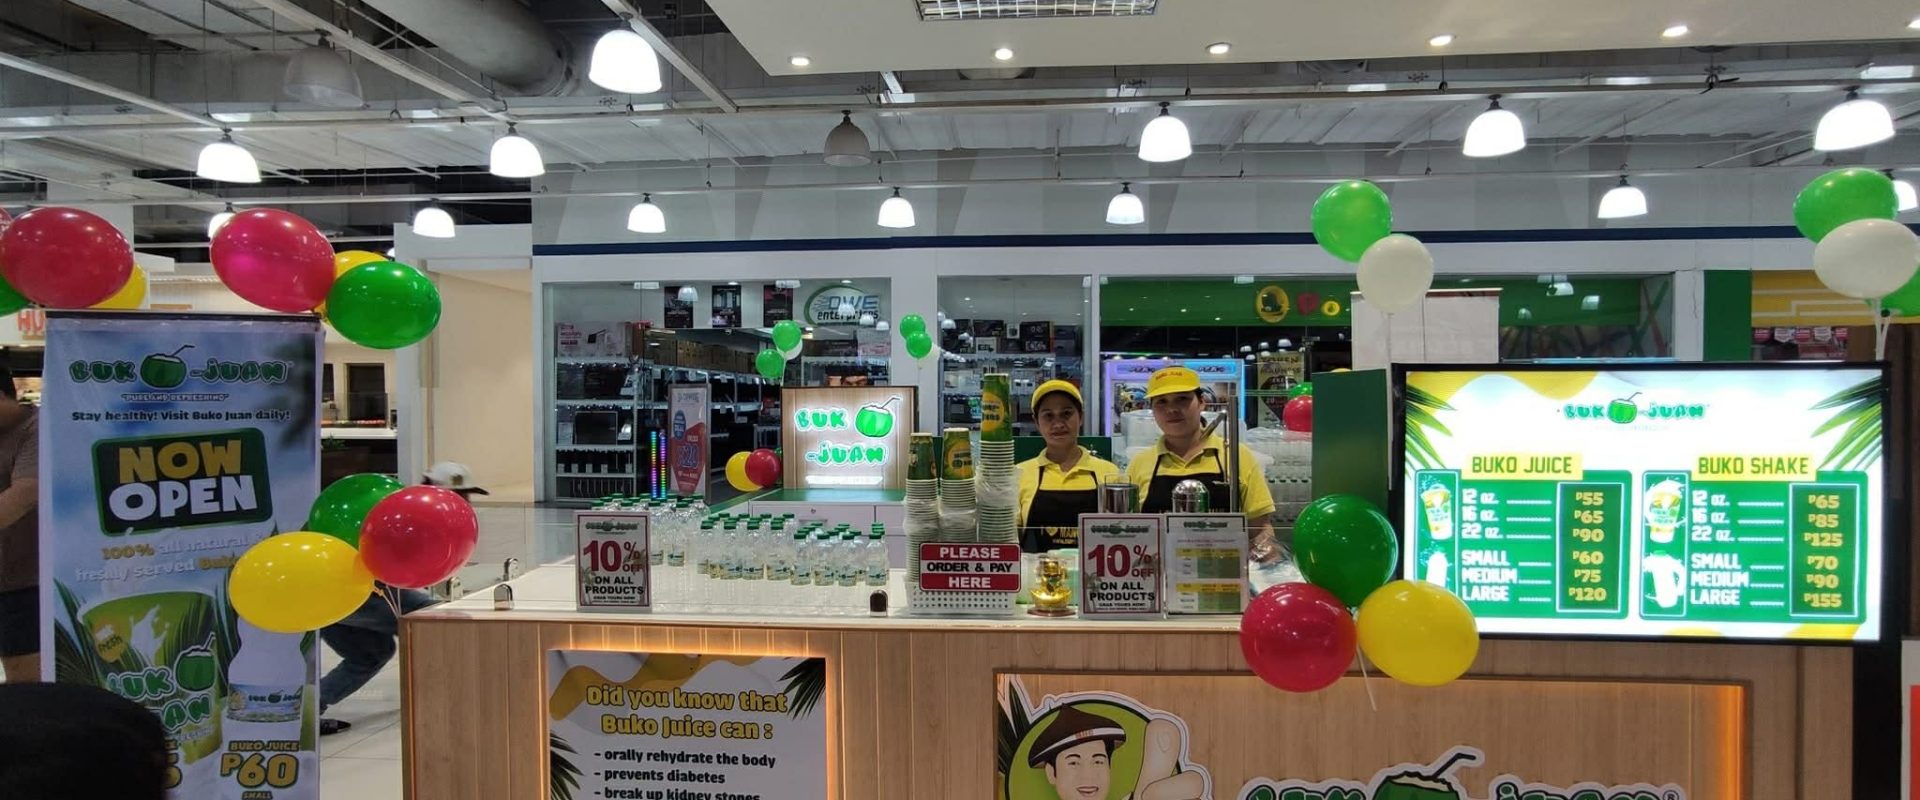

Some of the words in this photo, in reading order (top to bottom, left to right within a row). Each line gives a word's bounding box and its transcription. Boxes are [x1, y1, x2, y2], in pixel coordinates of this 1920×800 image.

[72, 411, 101, 421] Stay
[105, 410, 158, 421] healthy!
[161, 410, 188, 420] Visit
[192, 410, 223, 420] Buko
[224, 410, 252, 421] Juan
[255, 409, 290, 421] daily!
[119, 440, 242, 484] NOW
[1472, 456, 1518, 474] BUKO
[1523, 456, 1573, 474] JUICE
[1698, 457, 1744, 474] BUKO
[1750, 457, 1810, 474] SHAKE
[109, 475, 259, 522] OPEN
[1462, 488, 1477, 504] 12
[1692, 490, 1708, 506] 12
[1462, 506, 1477, 522] 16
[1692, 508, 1707, 524] 16
[1461, 523, 1482, 539] 22
[1691, 525, 1712, 542] 22
[101, 544, 155, 560] 100%
[159, 541, 182, 554] all
[186, 535, 250, 552] natural
[939, 547, 1001, 559] PLEASE
[1461, 550, 1510, 566] SMALL
[1691, 553, 1742, 569] SMALL
[75, 566, 130, 582] freshly
[134, 558, 196, 577] served
[622, 564, 644, 573] OFF
[926, 562, 970, 572] ORDER
[974, 562, 985, 572] &
[989, 562, 1013, 573] PAY
[1131, 568, 1155, 577] OFF
[1461, 568, 1518, 583] MEDIUM
[594, 576, 611, 585] ON
[613, 576, 634, 585] ALL
[948, 576, 991, 588] HERE
[1100, 582, 1118, 590] ON
[1122, 581, 1144, 590] ALL
[1691, 571, 1750, 587] MEDIUM
[585, 586, 645, 595] PRODUCTS
[1090, 592, 1156, 601] PRODUCTS
[1462, 586, 1509, 602] LARGE
[1690, 589, 1740, 605] LARGE
[586, 684, 624, 706] Did
[627, 691, 669, 710] you
[673, 687, 735, 711] know
[738, 690, 788, 712] that
[601, 713, 658, 735] Buko
[661, 714, 715, 739] Juice
[719, 721, 760, 740] can
[763, 723, 773, 739] :
[229, 740, 264, 752] BUKO
[265, 740, 300, 752] JUICE
[604, 748, 643, 763] orally
[646, 750, 713, 766] rehydrate
[716, 752, 738, 765] the
[742, 753, 776, 769] body
[604, 769, 664, 782] prevents
[667, 769, 725, 784] diabetes
[242, 791, 273, 800] SMALL
[604, 787, 643, 800] break
[646, 791, 662, 800] up
[666, 788, 711, 800] kidney
[714, 791, 760, 800] stones
